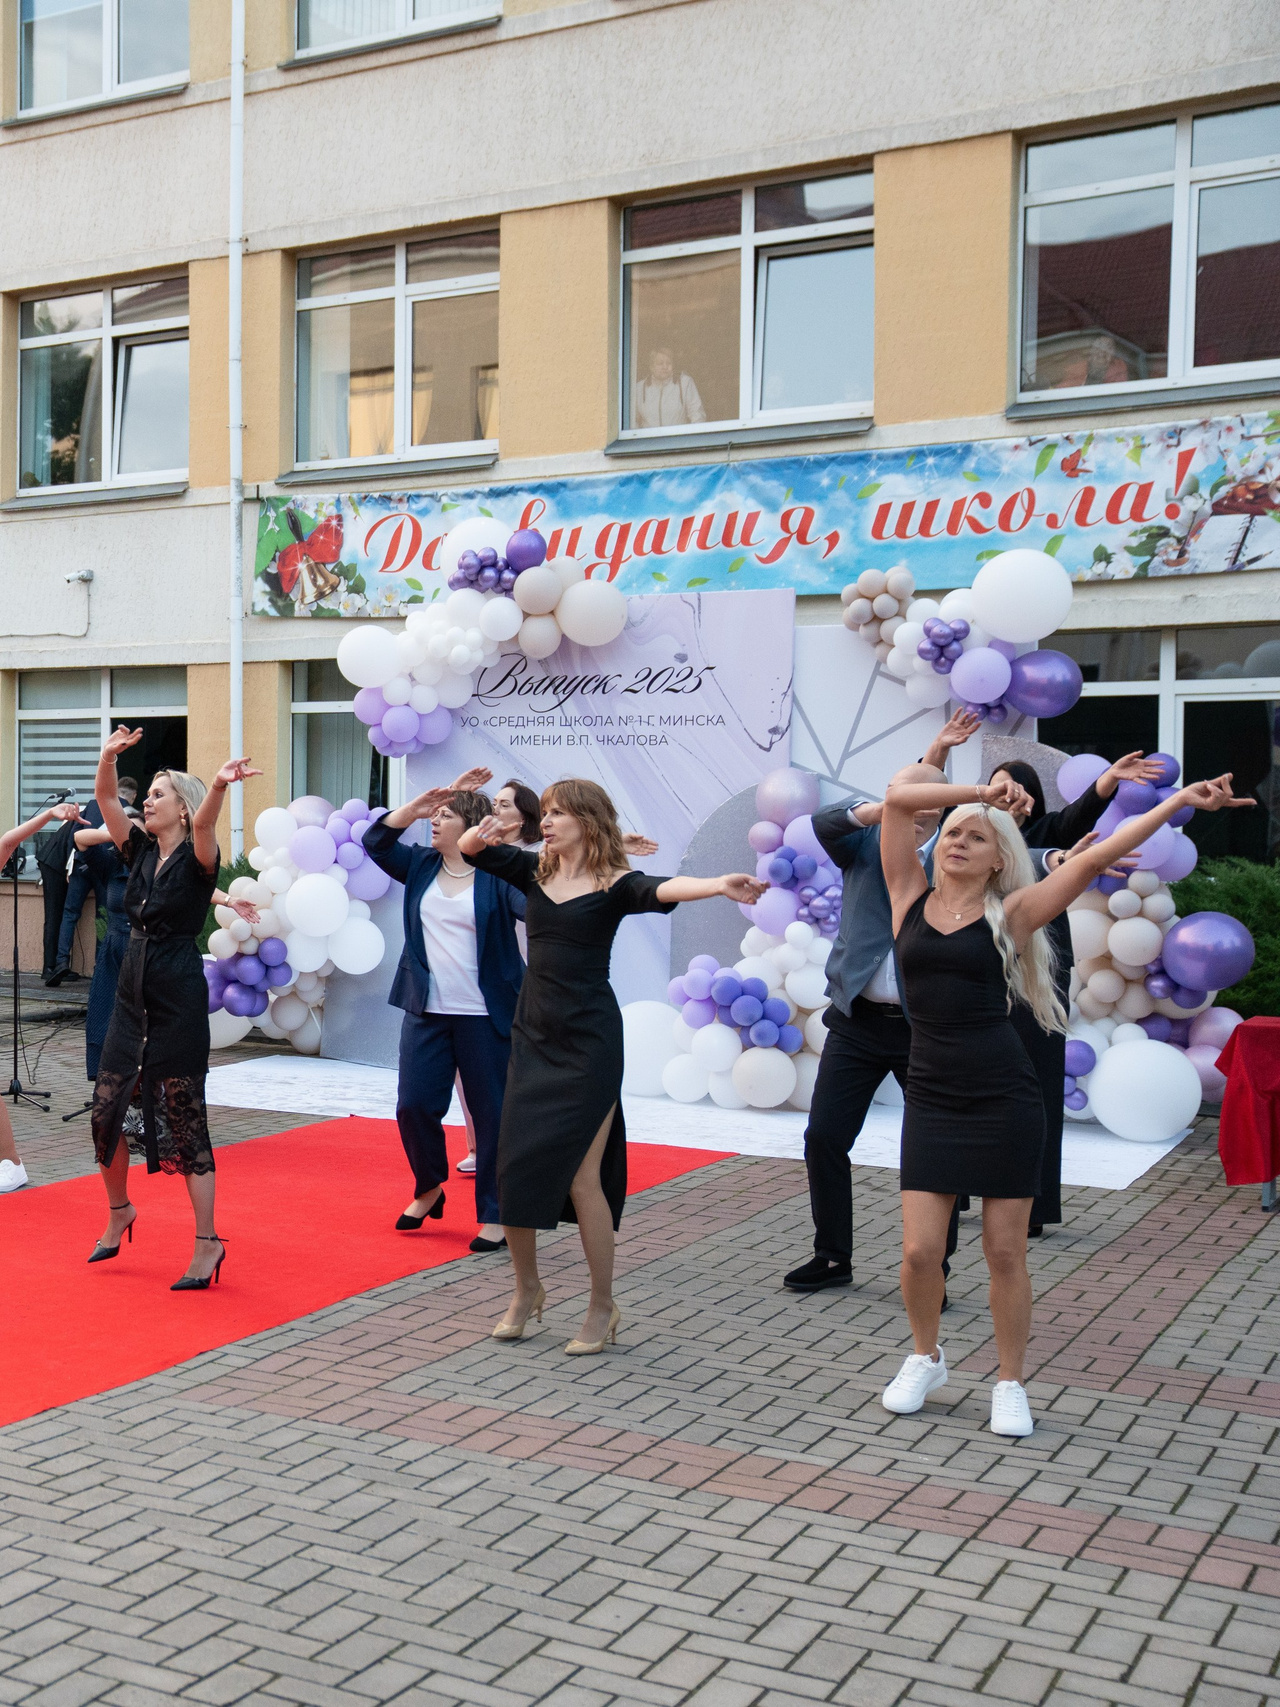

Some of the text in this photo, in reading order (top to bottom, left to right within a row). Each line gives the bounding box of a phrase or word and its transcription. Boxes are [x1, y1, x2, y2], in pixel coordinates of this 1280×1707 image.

[513, 497, 840, 584] идания,
[870, 446, 1198, 541] школа!
[471, 652, 717, 714] Выпуск 2025
[460, 715, 480, 728] УО
[483, 715, 555, 729] «СРЕДНЯЯ
[559, 714, 615, 727] ШКОЛА
[659, 714, 727, 727] МИНСКА
[509, 734, 669, 746] ИМЕНИ В.П. ЧКАЛОВА
